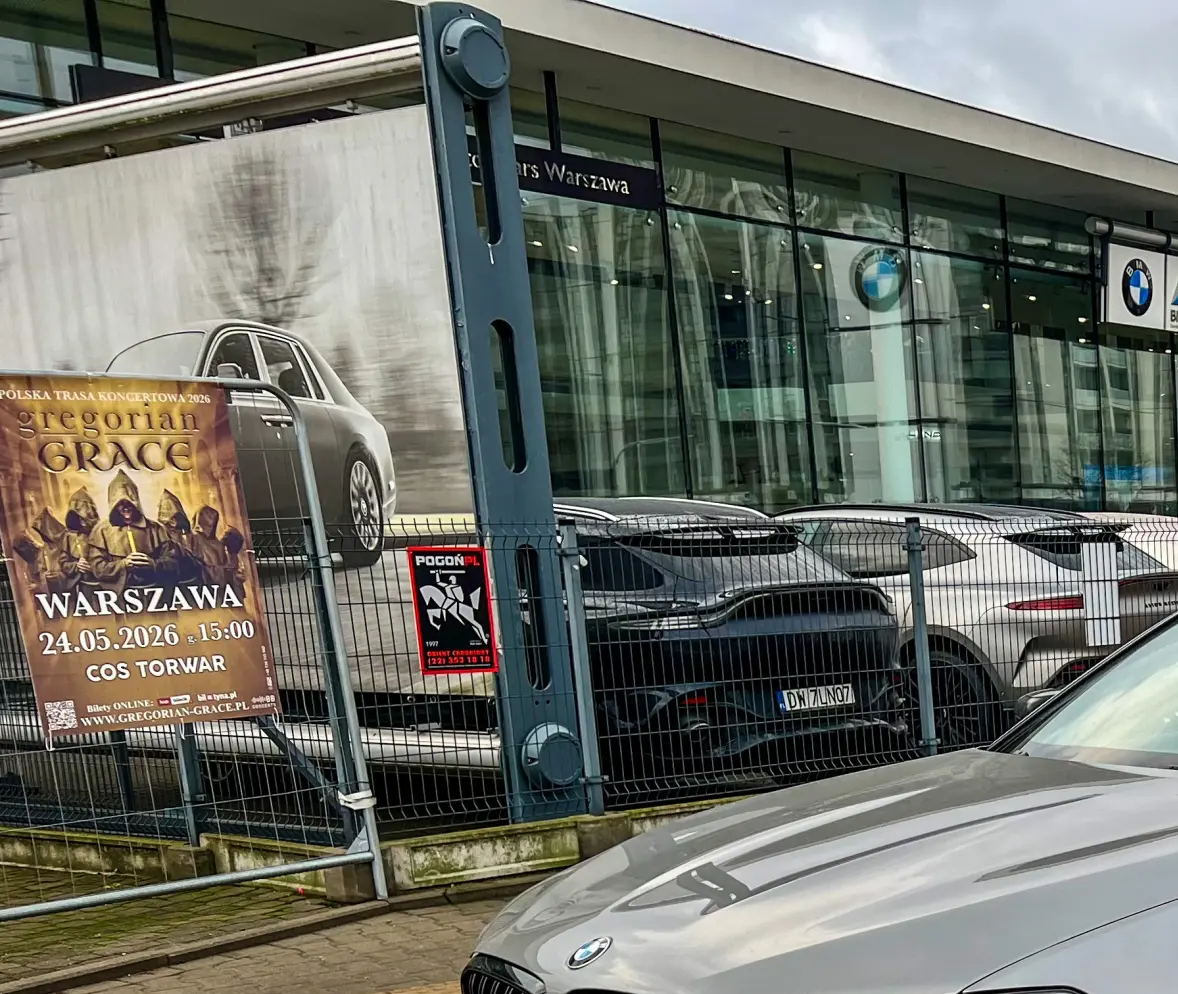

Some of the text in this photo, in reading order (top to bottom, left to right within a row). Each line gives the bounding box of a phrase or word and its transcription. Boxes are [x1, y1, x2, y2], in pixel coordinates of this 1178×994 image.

[516, 160, 629, 195] ars Warszawa
[0, 389, 211, 403] POLSKA TRASA KONCERTOWA 2026
[17, 402, 200, 439] gregorian
[38, 441, 193, 473] GRACE
[36, 583, 244, 619] WARSZAWA
[38, 624, 180, 656] 24.05.2026
[199, 620, 255, 642] 15:00
[86, 654, 227, 683] COS TORWAR
[80, 701, 250, 727] WWW.GREGORIAN-GRACE.PL
[86, 703, 111, 713] Bilety
[113, 700, 154, 711] ONLINE:
